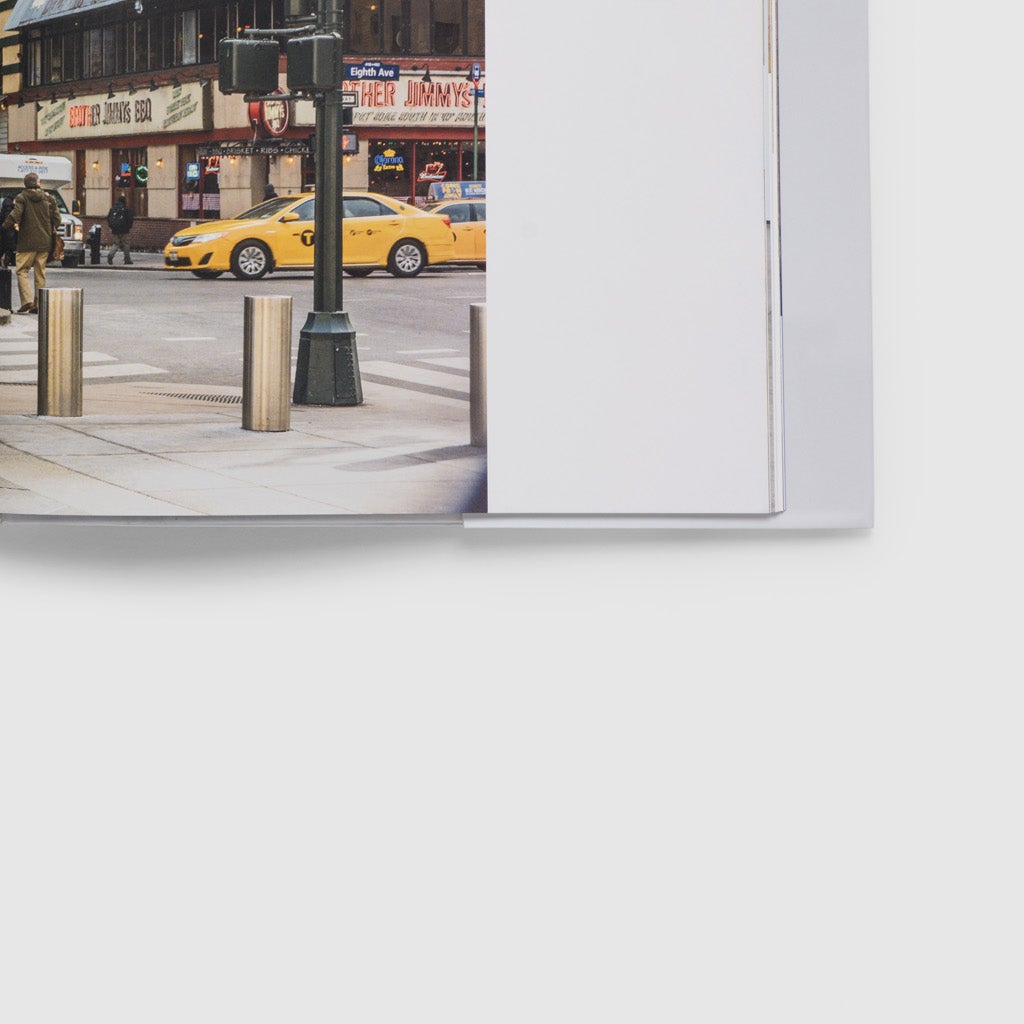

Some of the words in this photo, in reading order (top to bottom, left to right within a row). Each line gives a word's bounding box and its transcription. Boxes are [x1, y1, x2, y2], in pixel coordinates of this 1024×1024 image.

[350, 67, 377, 79] Eighth
[378, 67, 395, 77] Ave
[69, 103, 101, 128] BROTHER
[134, 97, 152, 123] BBQ
[374, 154, 404, 166] Corona
